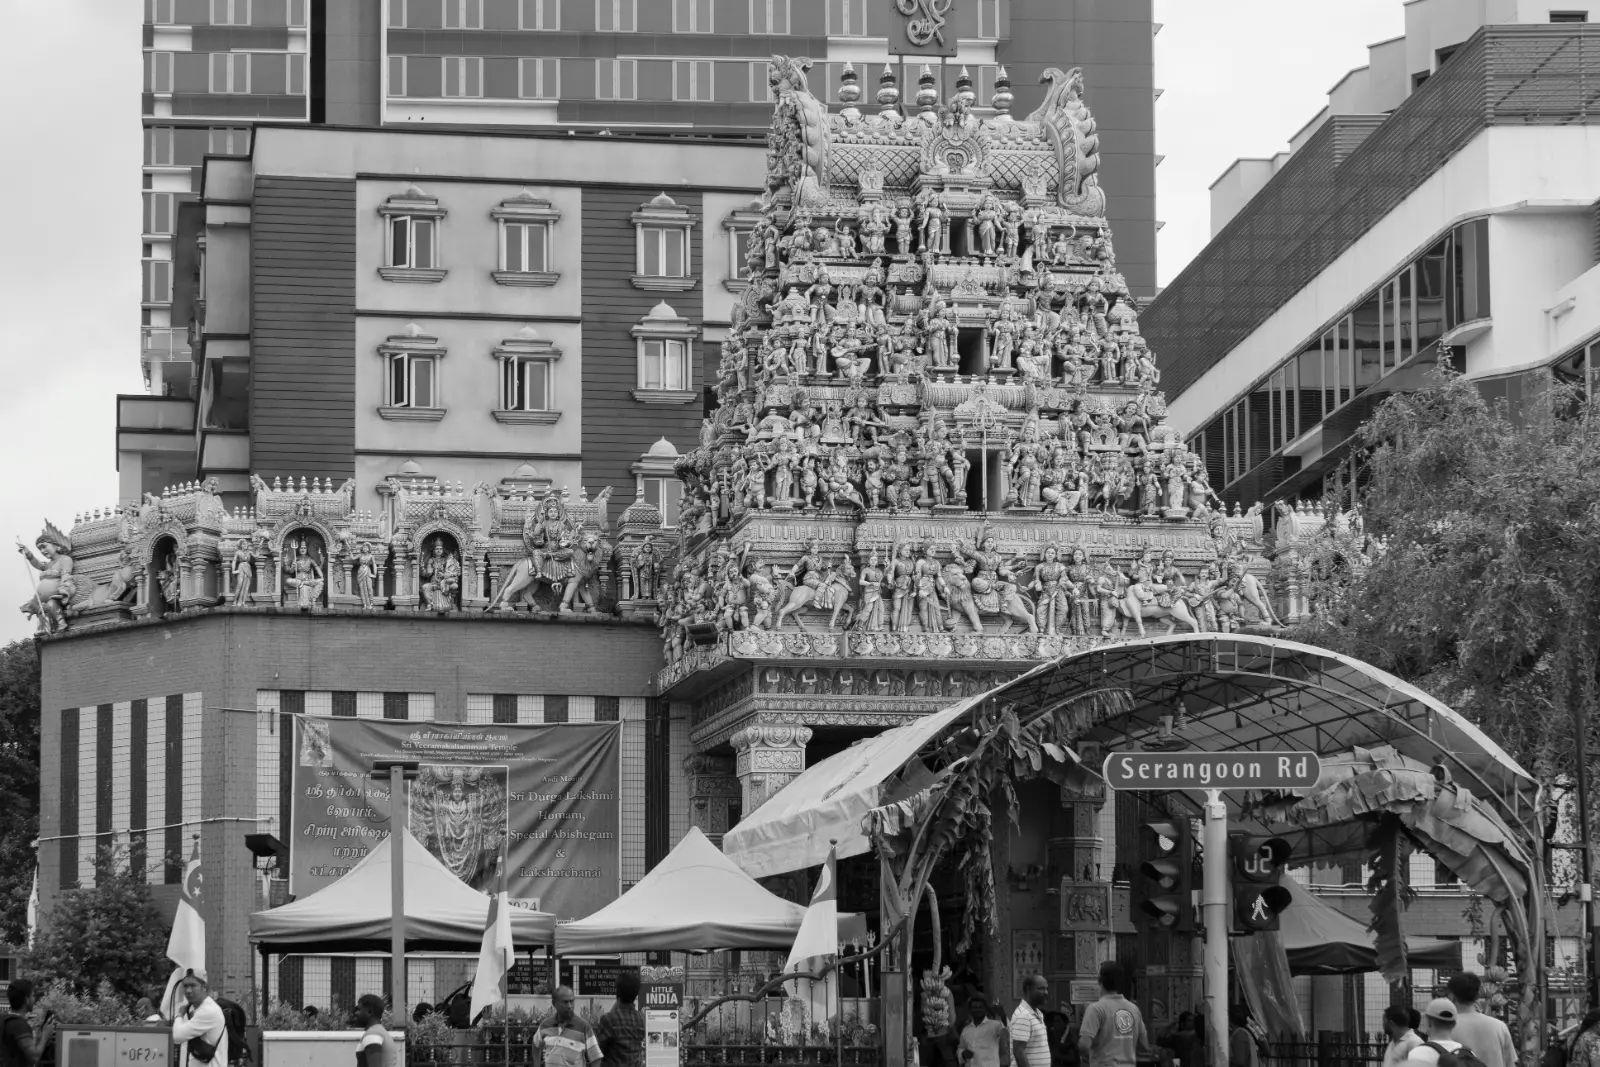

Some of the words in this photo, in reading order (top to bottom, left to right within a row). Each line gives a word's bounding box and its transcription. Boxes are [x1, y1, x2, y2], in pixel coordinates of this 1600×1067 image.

[401, 741, 412, 749] Sri
[488, 743, 517, 752] Temple
[1121, 757, 1261, 784] Serangoon
[1278, 756, 1308, 778] Rd
[510, 791, 525, 801] Sri
[528, 791, 562, 803] Durga
[565, 790, 613, 801] Lakshmi
[538, 810, 586, 822] Homam,
[510, 829, 548, 842] Special
[552, 829, 613, 842] Abishegam
[555, 848, 566, 858] &
[519, 866, 602, 879] Laksharchanai
[646, 992, 679, 1004] INDIA
